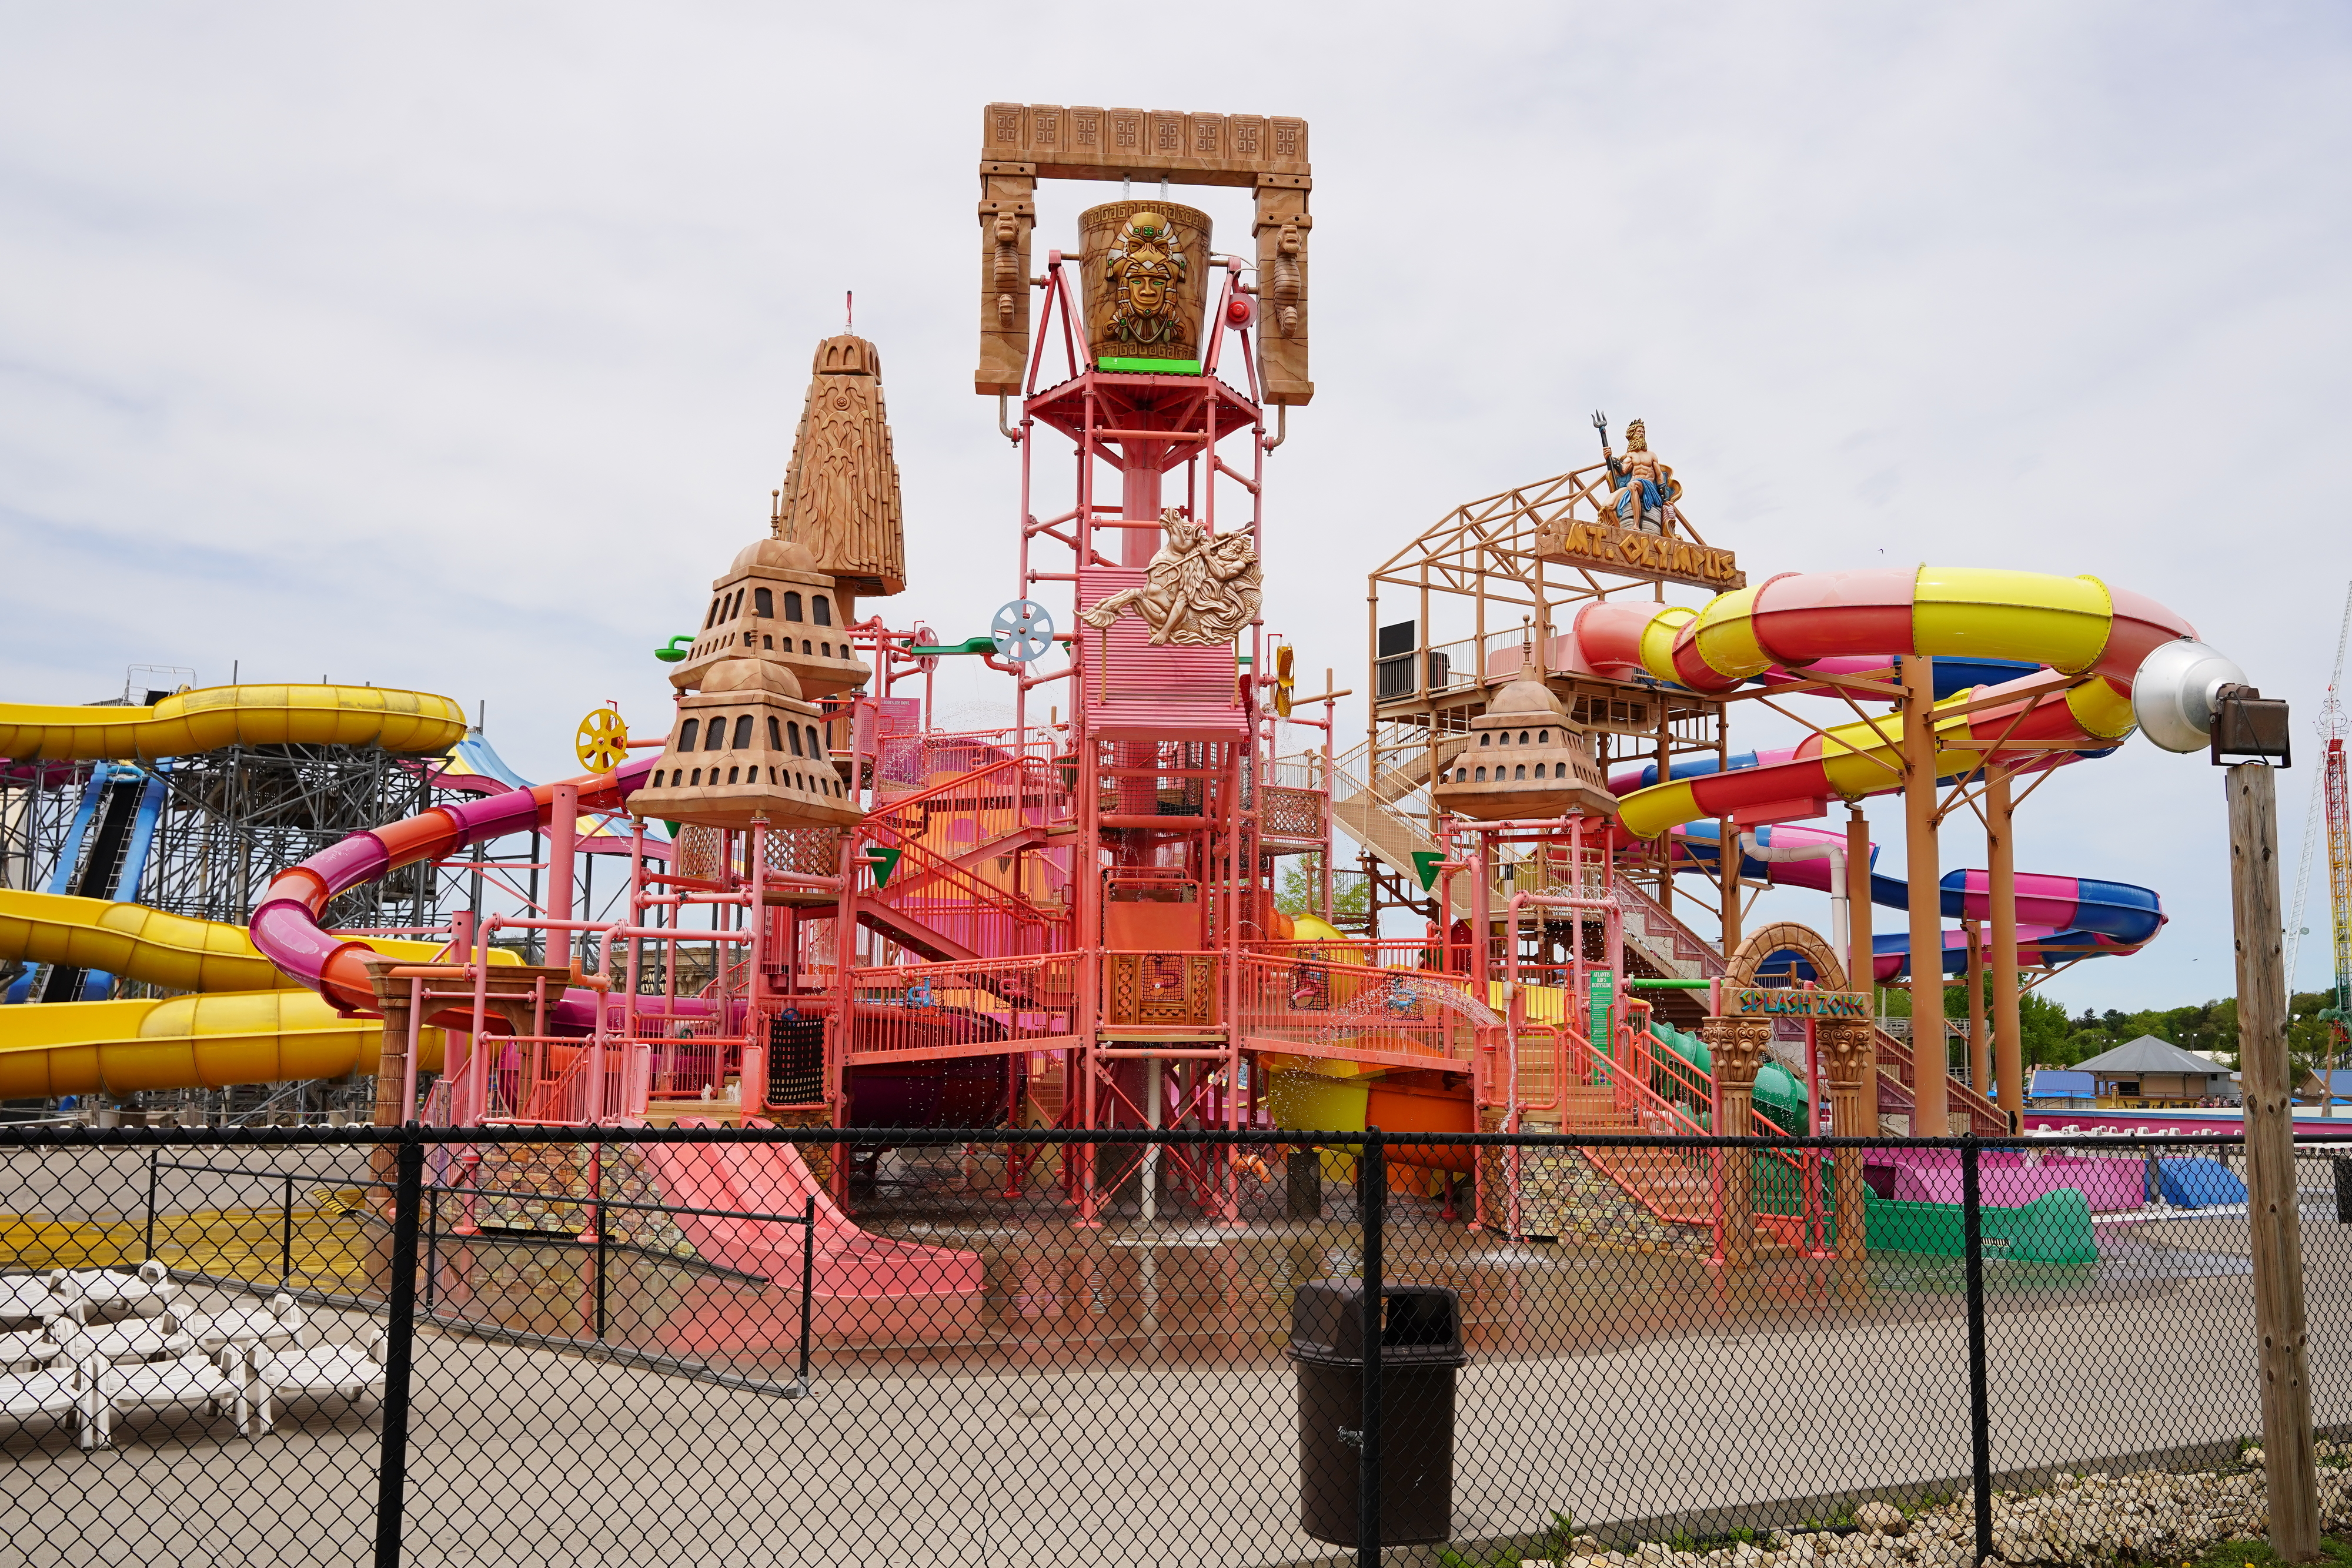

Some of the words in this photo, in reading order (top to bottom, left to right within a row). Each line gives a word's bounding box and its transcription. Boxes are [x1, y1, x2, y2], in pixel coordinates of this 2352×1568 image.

[1565, 522, 1614, 560] MT.
[1619, 533, 1735, 582] OLYMPUS
[1739, 989, 1811, 1015] SPLASH
[1816, 994, 1865, 1015] ZONE
